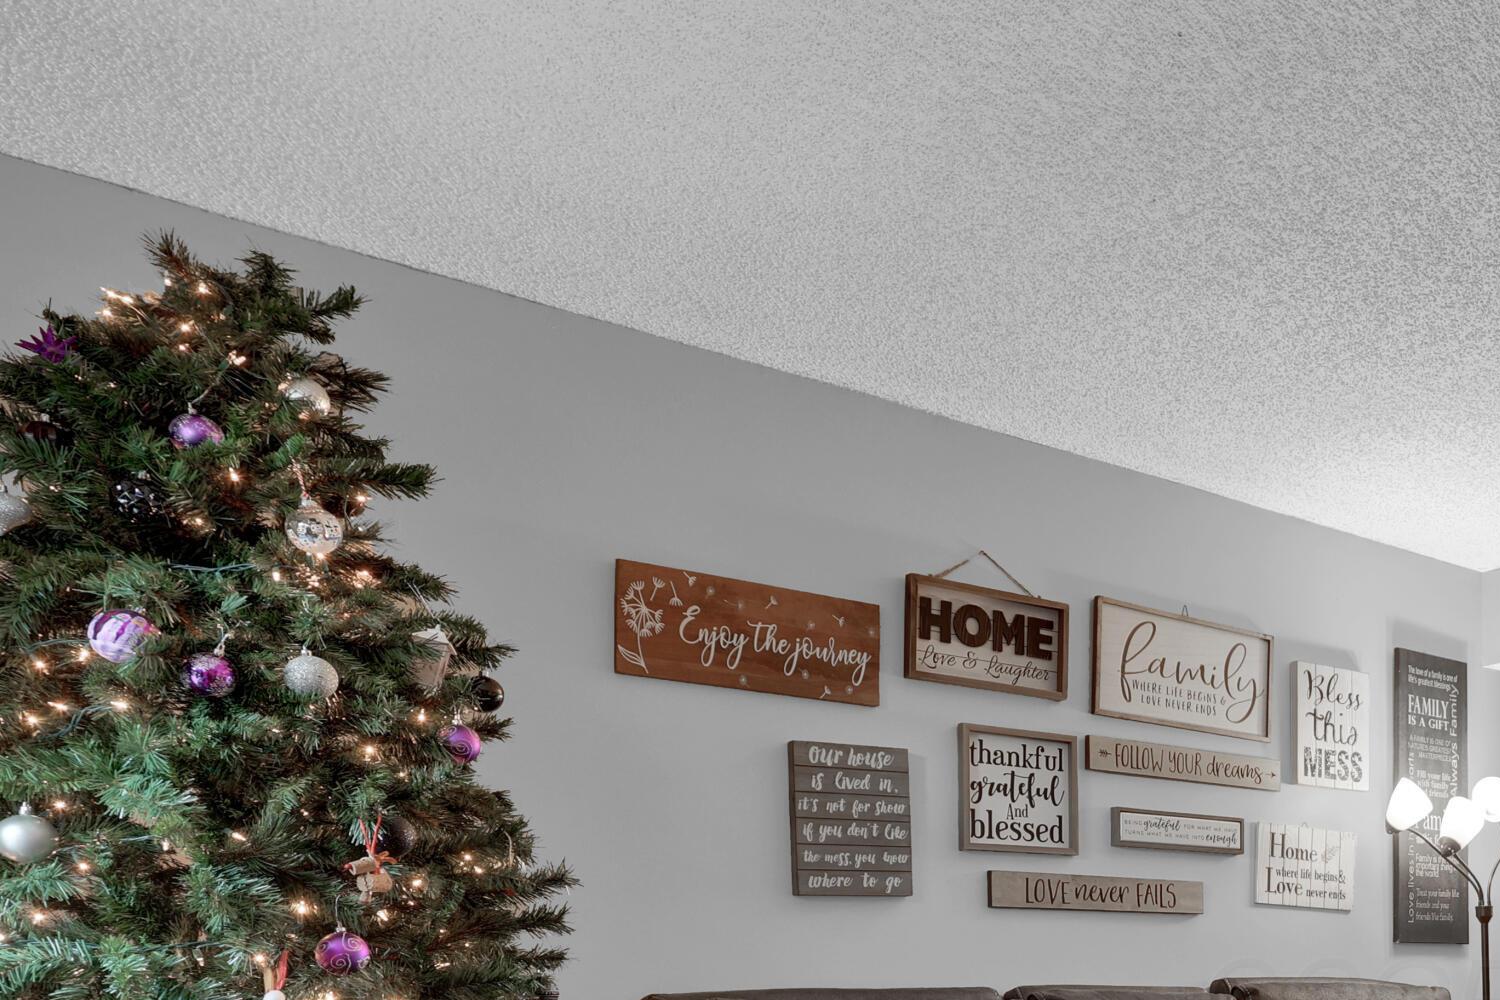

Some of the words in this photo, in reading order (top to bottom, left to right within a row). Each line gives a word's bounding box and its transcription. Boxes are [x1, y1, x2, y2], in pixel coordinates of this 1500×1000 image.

[918, 596, 1054, 661] HOME
[679, 605, 749, 670] Enjoy
[747, 620, 792, 654] the
[783, 636, 872, 687] journey
[918, 644, 956, 669] Love
[962, 650, 977, 669] &
[984, 655, 1049, 686] Laughter
[1118, 621, 1264, 724] family
[1132, 679, 1161, 694] WHERE
[1304, 669, 1363, 711] Bless
[1141, 694, 1161, 706] LOVE
[1165, 698, 1192, 713] NEVER
[1195, 704, 1217, 716] ENDS
[1408, 693, 1449, 719] FAMILY
[1449, 684, 1460, 736] Family
[1305, 708, 1358, 746] this
[1408, 714, 1416, 725] IS
[1419, 717, 1426, 727] A
[1428, 718, 1450, 731] GIFT
[847, 747, 894, 769] house
[969, 739, 1064, 771] thankful
[1114, 743, 1164, 773] FOLLOW
[1206, 756, 1264, 784] dreams
[1303, 746, 1363, 783] MESS
[1450, 742, 1460, 797] Always
[811, 773, 824, 791] is
[834, 771, 871, 790] lived
[970, 770, 1065, 809] grateful
[798, 797, 819, 813] it's
[826, 797, 847, 813] not
[852, 800, 871, 818] for
[875, 800, 906, 816] show
[1006, 803, 1029, 820] And
[819, 824, 842, 843] you
[847, 822, 880, 839] don't
[884, 823, 909, 840] like
[970, 808, 1065, 844] blessed
[1143, 817, 1182, 832] grateful
[802, 850, 821, 862] the
[854, 853, 877, 869] you
[882, 851, 909, 865] know
[1269, 831, 1318, 862] Home
[808, 873, 853, 888] where
[861, 872, 878, 888] to
[885, 876, 903, 893] go
[1264, 866, 1303, 896] Love
[1305, 887, 1327, 898] never
[1328, 890, 1346, 900] ends
[1275, 867, 1298, 879] where
[1300, 868, 1312, 879] life
[1314, 869, 1338, 883] begins
[1338, 869, 1346, 884] &
[1025, 877, 1071, 905] LOVE
[1074, 883, 1130, 903] never
[1136, 882, 1177, 909] FAILS
